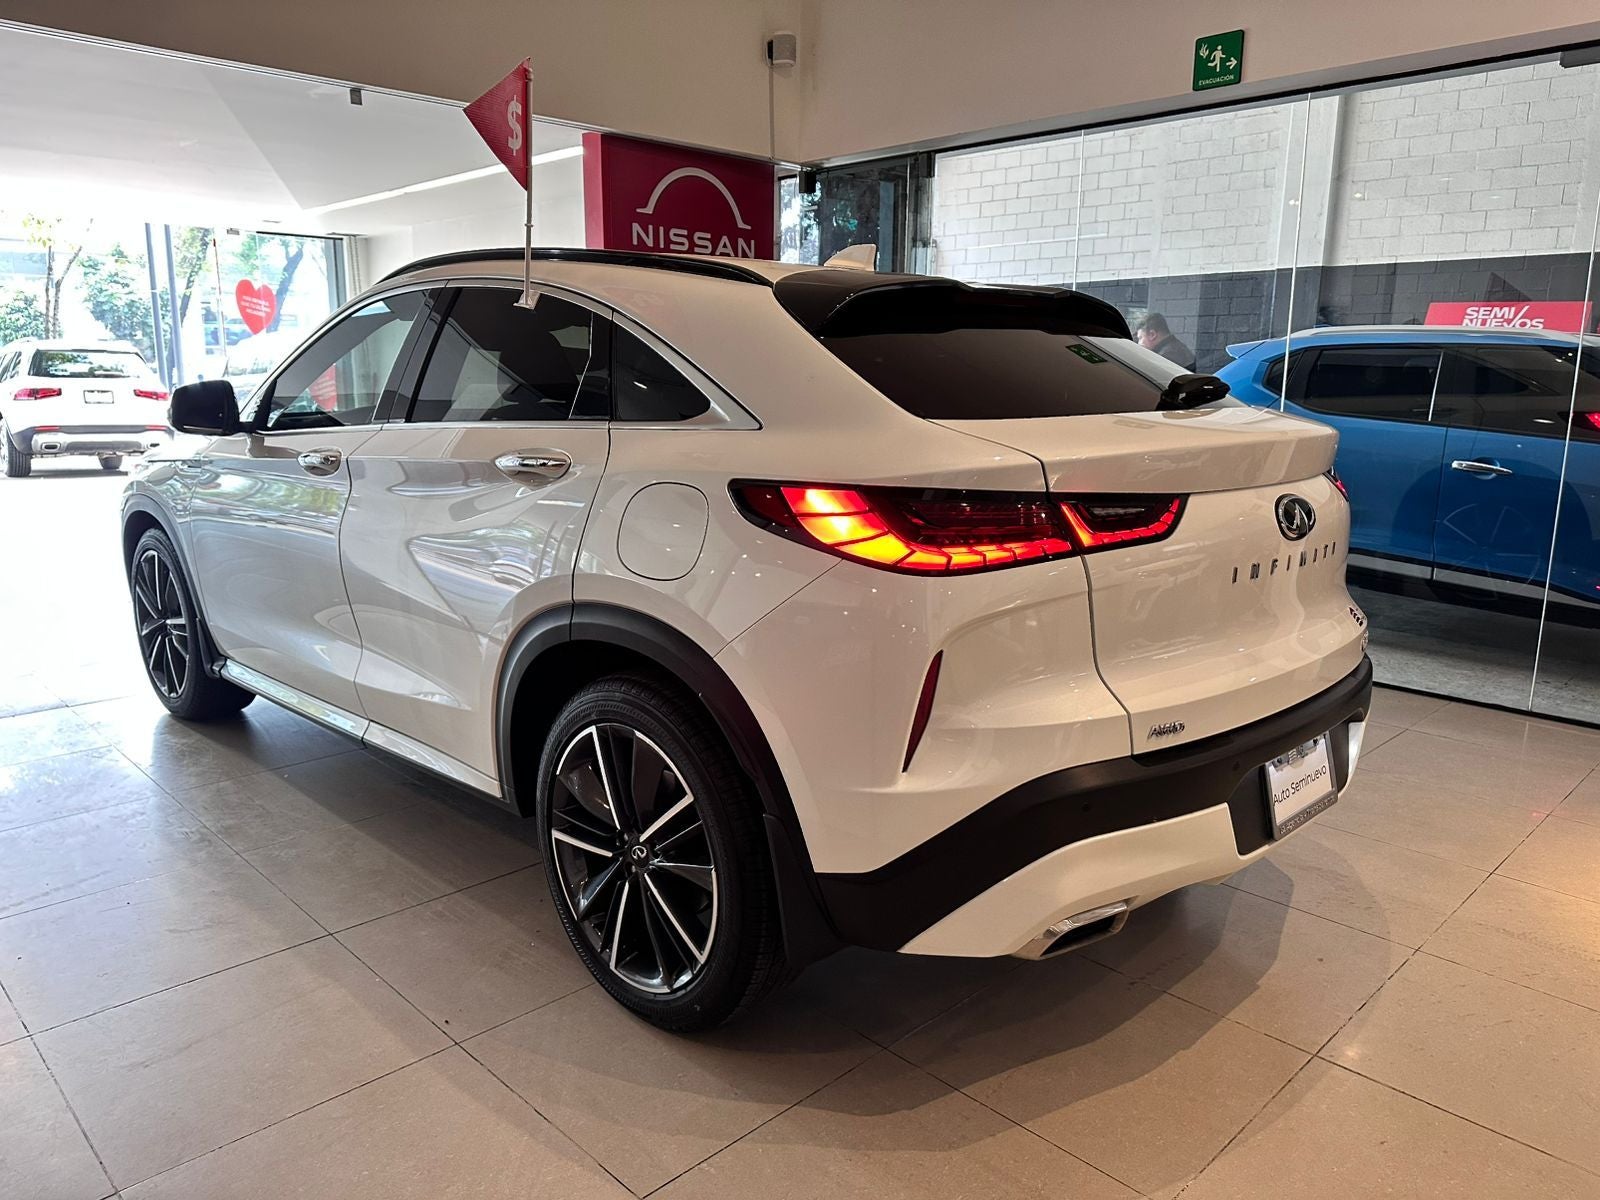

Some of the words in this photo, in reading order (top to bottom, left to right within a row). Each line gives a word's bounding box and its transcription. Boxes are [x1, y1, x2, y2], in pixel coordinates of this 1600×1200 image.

[1198, 74, 1235, 86] EVACUACIÓN
[507, 94, 523, 156] $
[632, 222, 755, 259] NISSAN
[1464, 306, 1517, 319] SEMI
[1232, 541, 1336, 584] INFINITI
[1147, 720, 1185, 740] AWD
[1273, 788, 1290, 806] Auto
[1290, 765, 1327, 795] Seminuevo
